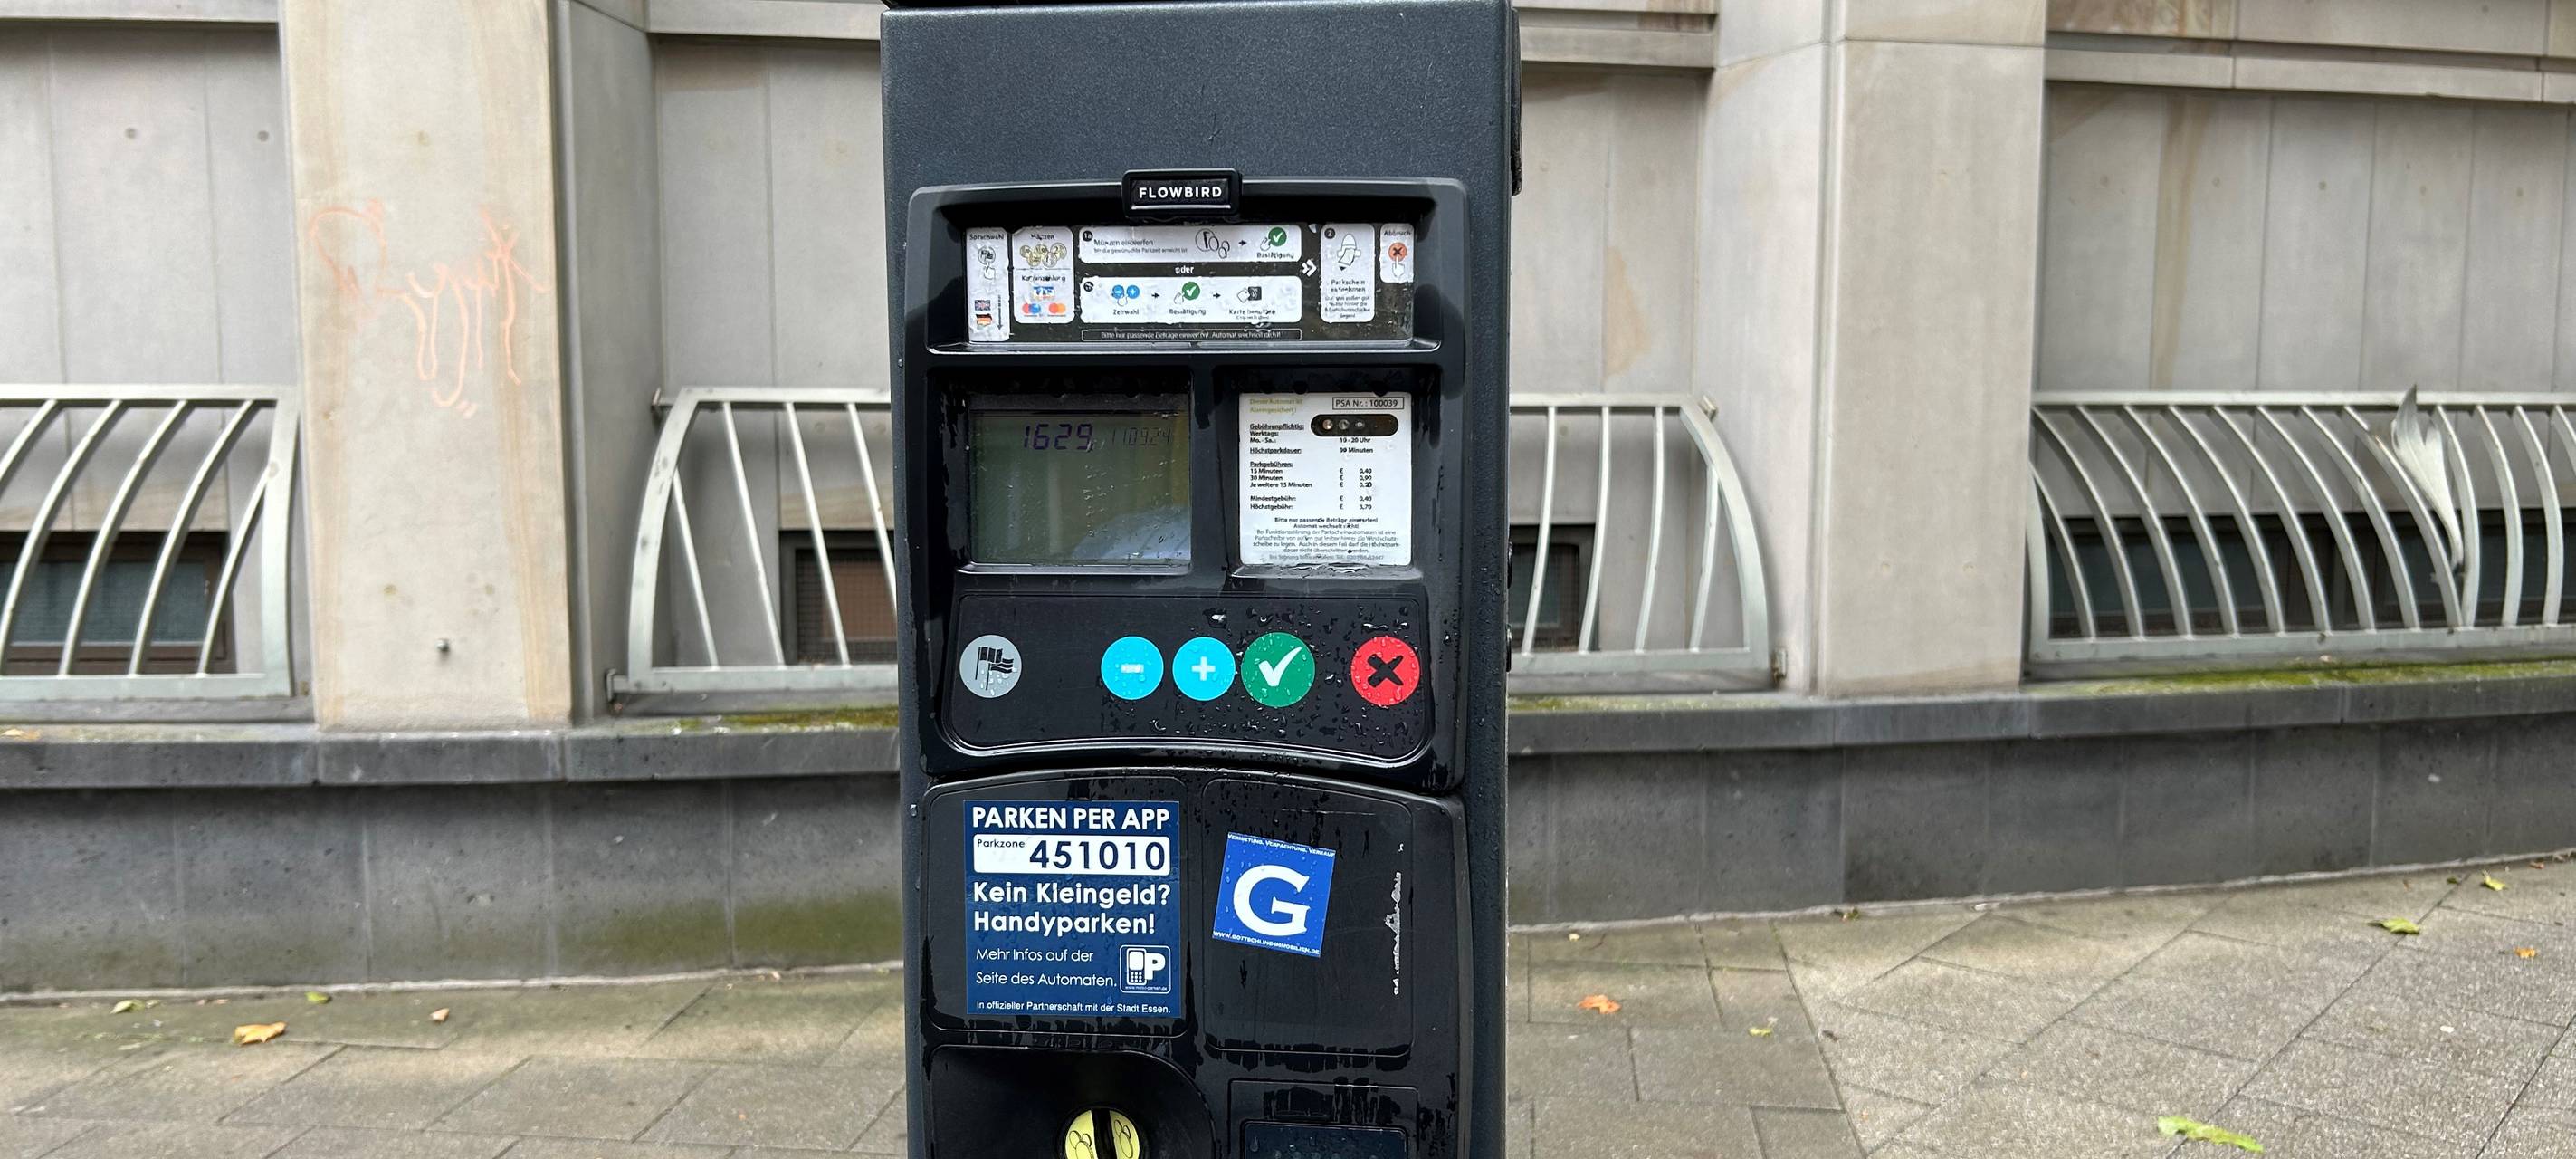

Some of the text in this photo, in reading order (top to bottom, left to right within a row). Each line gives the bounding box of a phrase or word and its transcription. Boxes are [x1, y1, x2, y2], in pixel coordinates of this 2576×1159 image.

[1139, 187, 1222, 198] FLOWBIRD
[1175, 265, 1195, 273] oder
[1336, 399, 1350, 407] PSA
[1352, 399, 1363, 407] Nr.
[1369, 399, 1398, 407] 100039
[1024, 424, 1093, 451] 1629
[972, 807, 1169, 830] PARKEN PER APP
[977, 838, 1165, 871] Parkzone 451010
[974, 882, 1171, 908] Kein Kleingeld?
[1233, 864, 1311, 936] G
[974, 911, 1155, 937] Handyparken!
[976, 949, 1093, 962] Mehr Infos auf der
[976, 971, 1117, 987] Seite des Automaten.
[977, 1001, 1171, 1014] In offizieller Partnerschaft mit der Stadt Essen.
